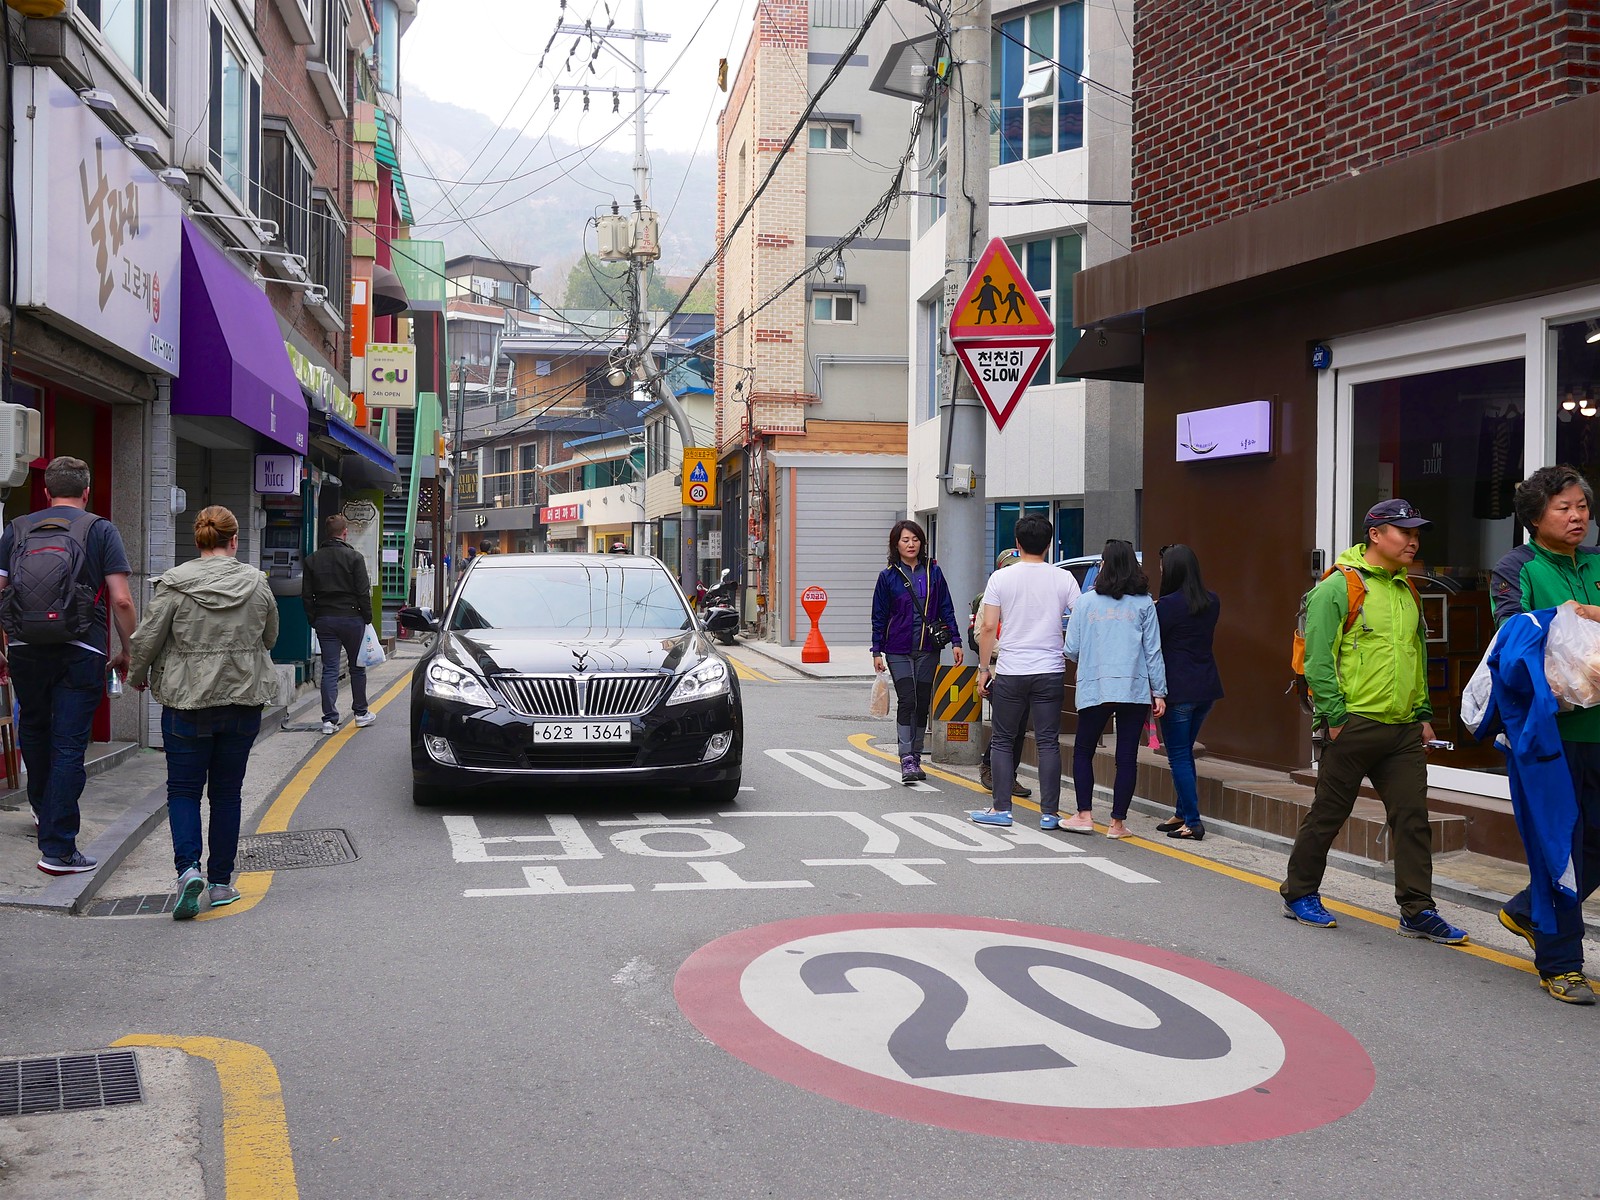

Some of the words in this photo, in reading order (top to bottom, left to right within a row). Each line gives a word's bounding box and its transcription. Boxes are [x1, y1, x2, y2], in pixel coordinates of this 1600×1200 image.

[122, 257, 150, 313] 고로케
[151, 334, 175, 363] 741-1001
[978, 351, 1023, 366] 천천히
[1313, 352, 1323, 362] ADT
[983, 368, 1019, 381] SLOW
[264, 461, 274, 473] MY
[264, 474, 284, 487] JUICE
[693, 489, 703, 497] 20
[543, 726, 573, 740] 62호
[583, 725, 622, 740] 1364
[442, 811, 1161, 897] 보호구역
[800, 945, 1231, 1078] 20
